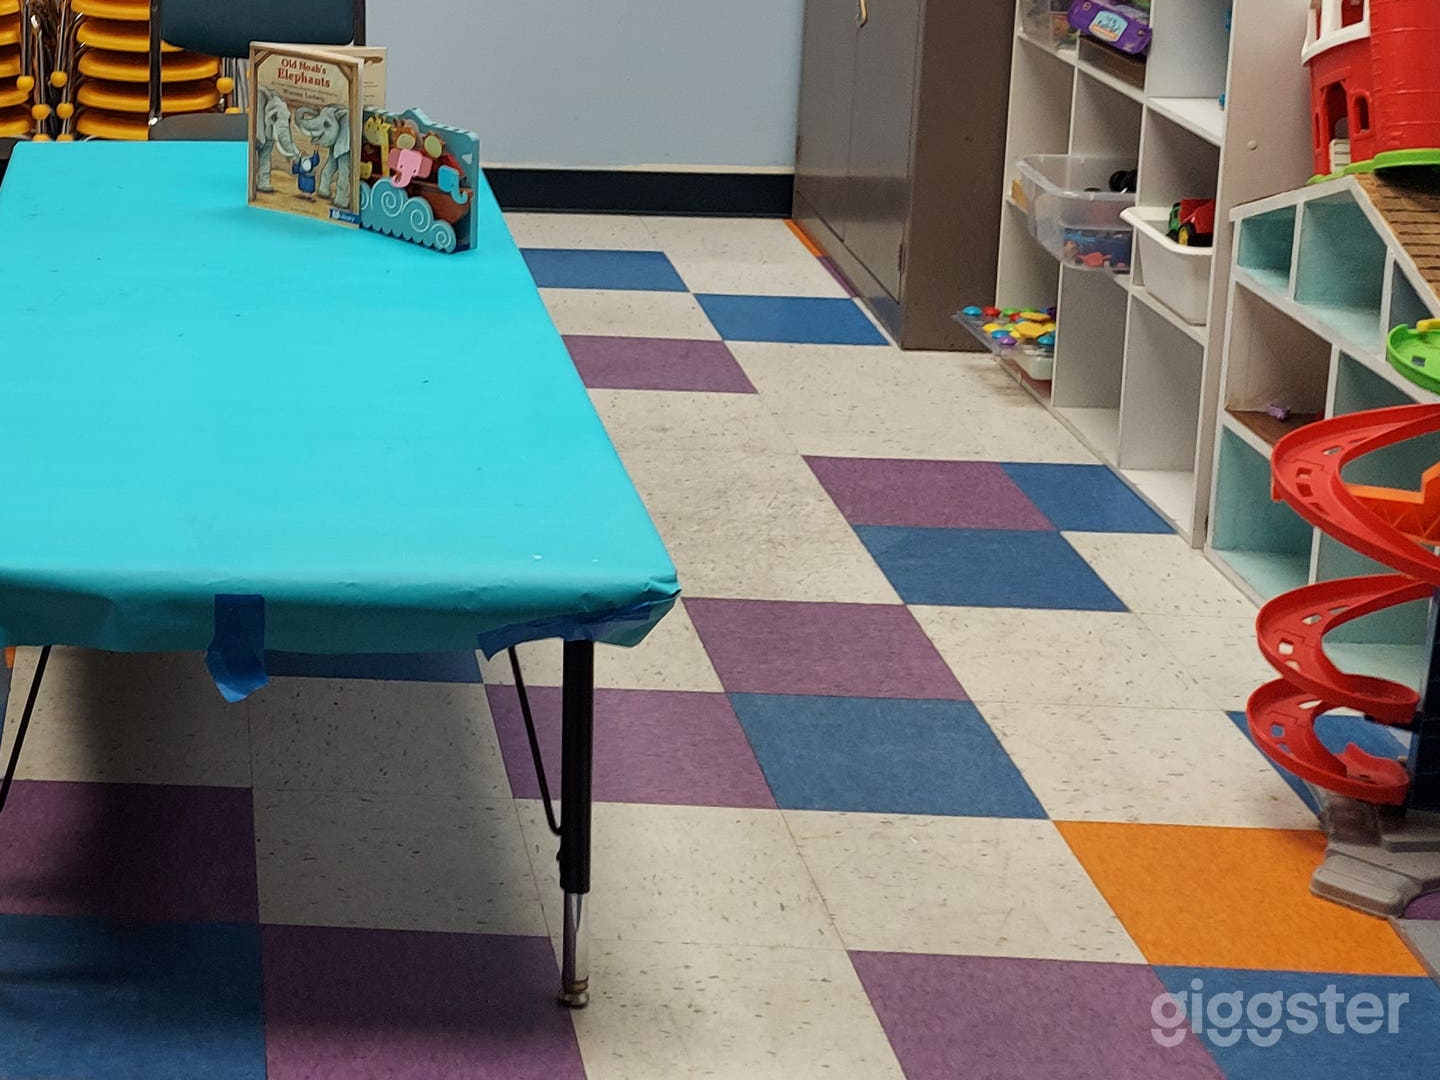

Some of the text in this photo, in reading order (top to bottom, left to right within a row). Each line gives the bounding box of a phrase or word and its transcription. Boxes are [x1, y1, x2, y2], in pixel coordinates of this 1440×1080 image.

[280, 58, 327, 75] Old Noah's
[277, 67, 331, 88] Elephants
